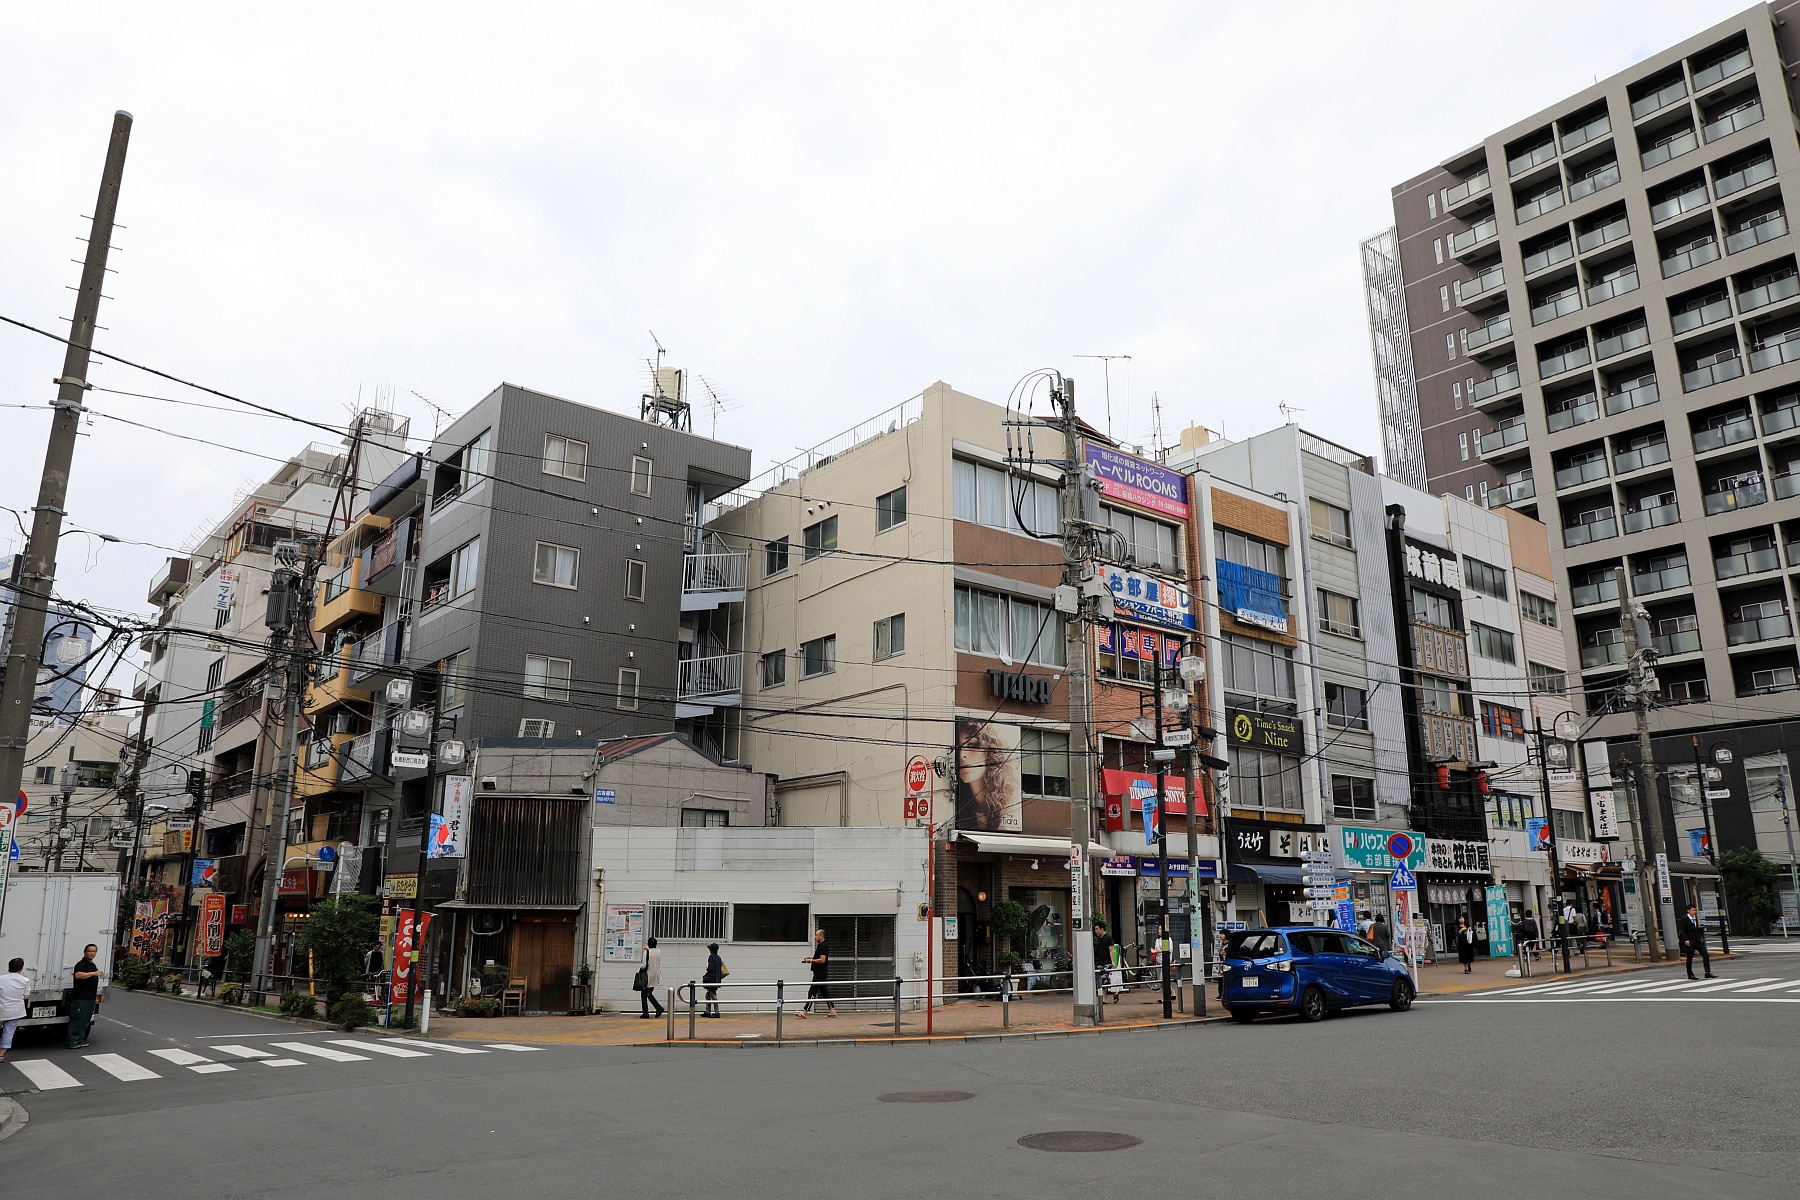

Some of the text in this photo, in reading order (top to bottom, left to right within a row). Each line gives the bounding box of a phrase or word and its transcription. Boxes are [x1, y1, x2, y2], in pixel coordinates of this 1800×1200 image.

[1109, 573, 1191, 608] お部屋探し
[987, 669, 1052, 704] TIARA
[1264, 731, 1289, 748] Nine
[1237, 831, 1264, 852] うえ竹
